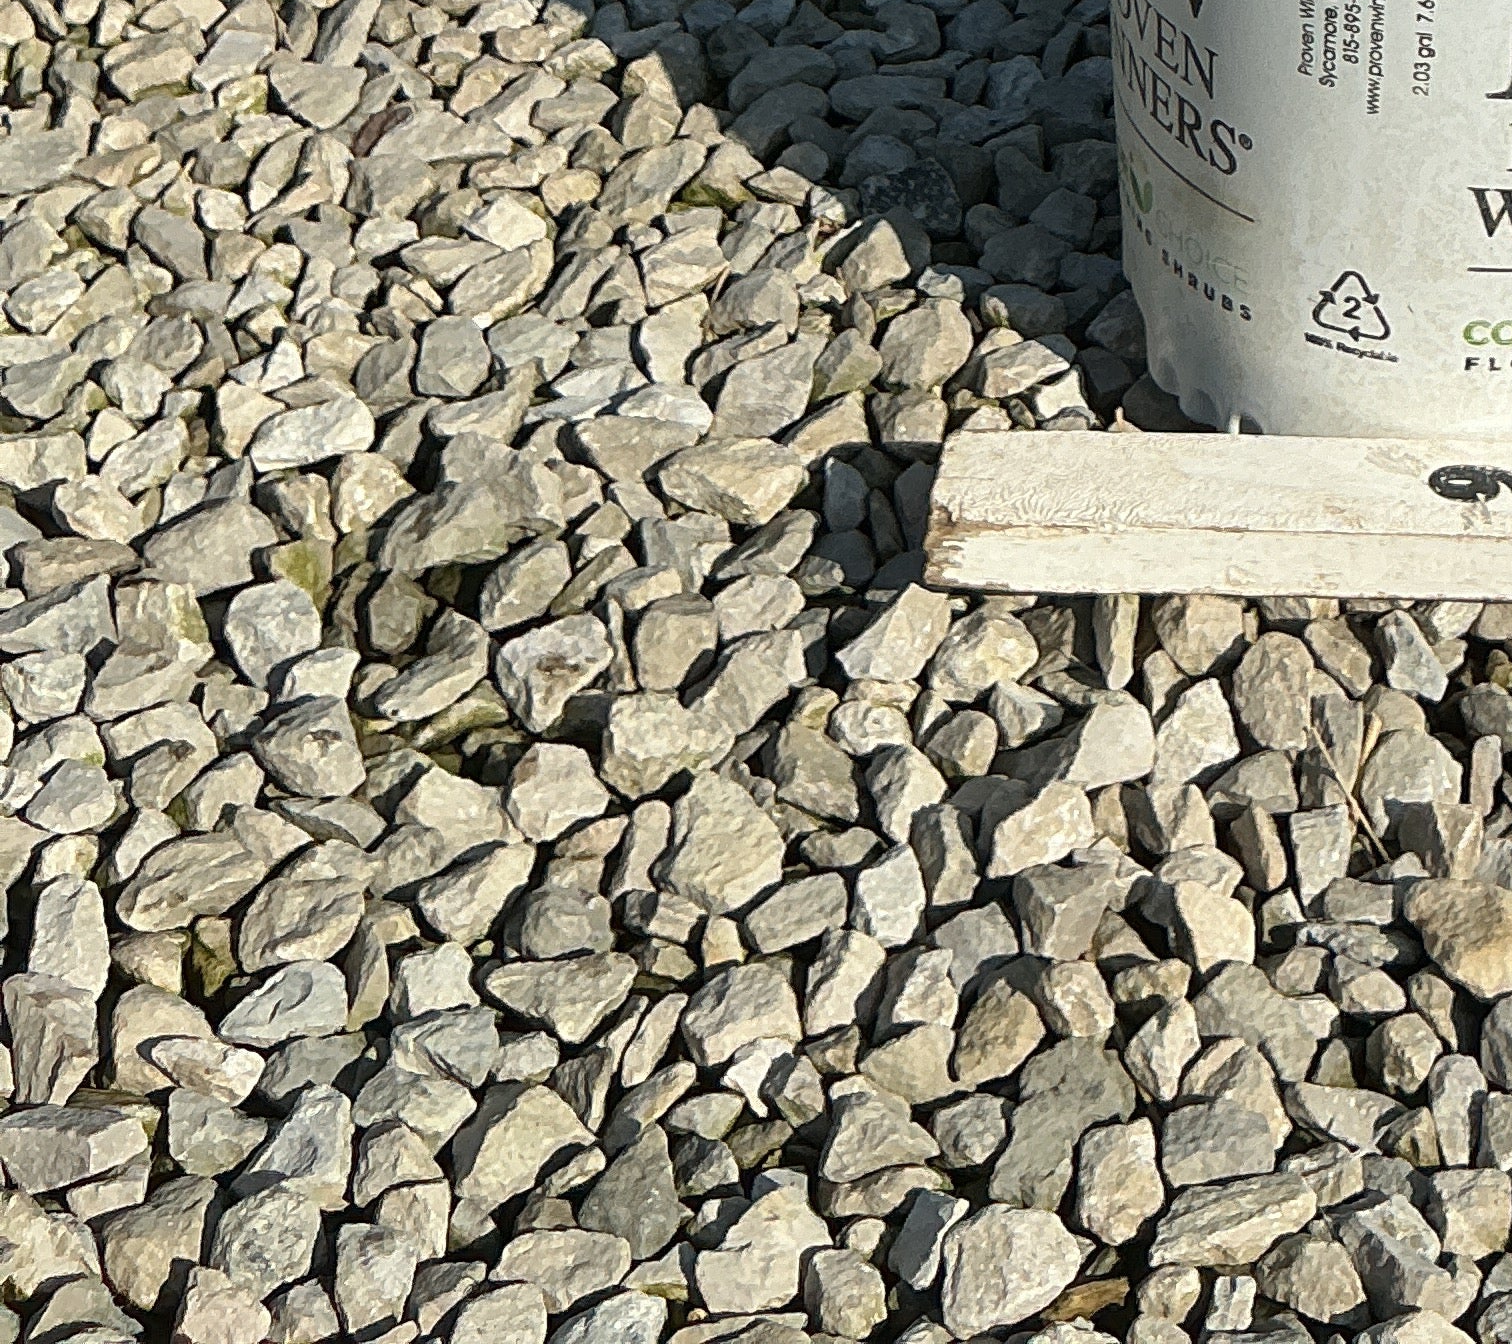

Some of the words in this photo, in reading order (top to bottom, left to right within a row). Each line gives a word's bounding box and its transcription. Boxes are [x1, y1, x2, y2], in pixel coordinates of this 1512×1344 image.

[1297, 23, 1315, 76] Proven
[1318, 6, 1339, 88] Sycamore,
[1415, 32, 1436, 59] gal
[1412, 62, 1432, 97] 2.03
[1342, 295, 1362, 320] 2
